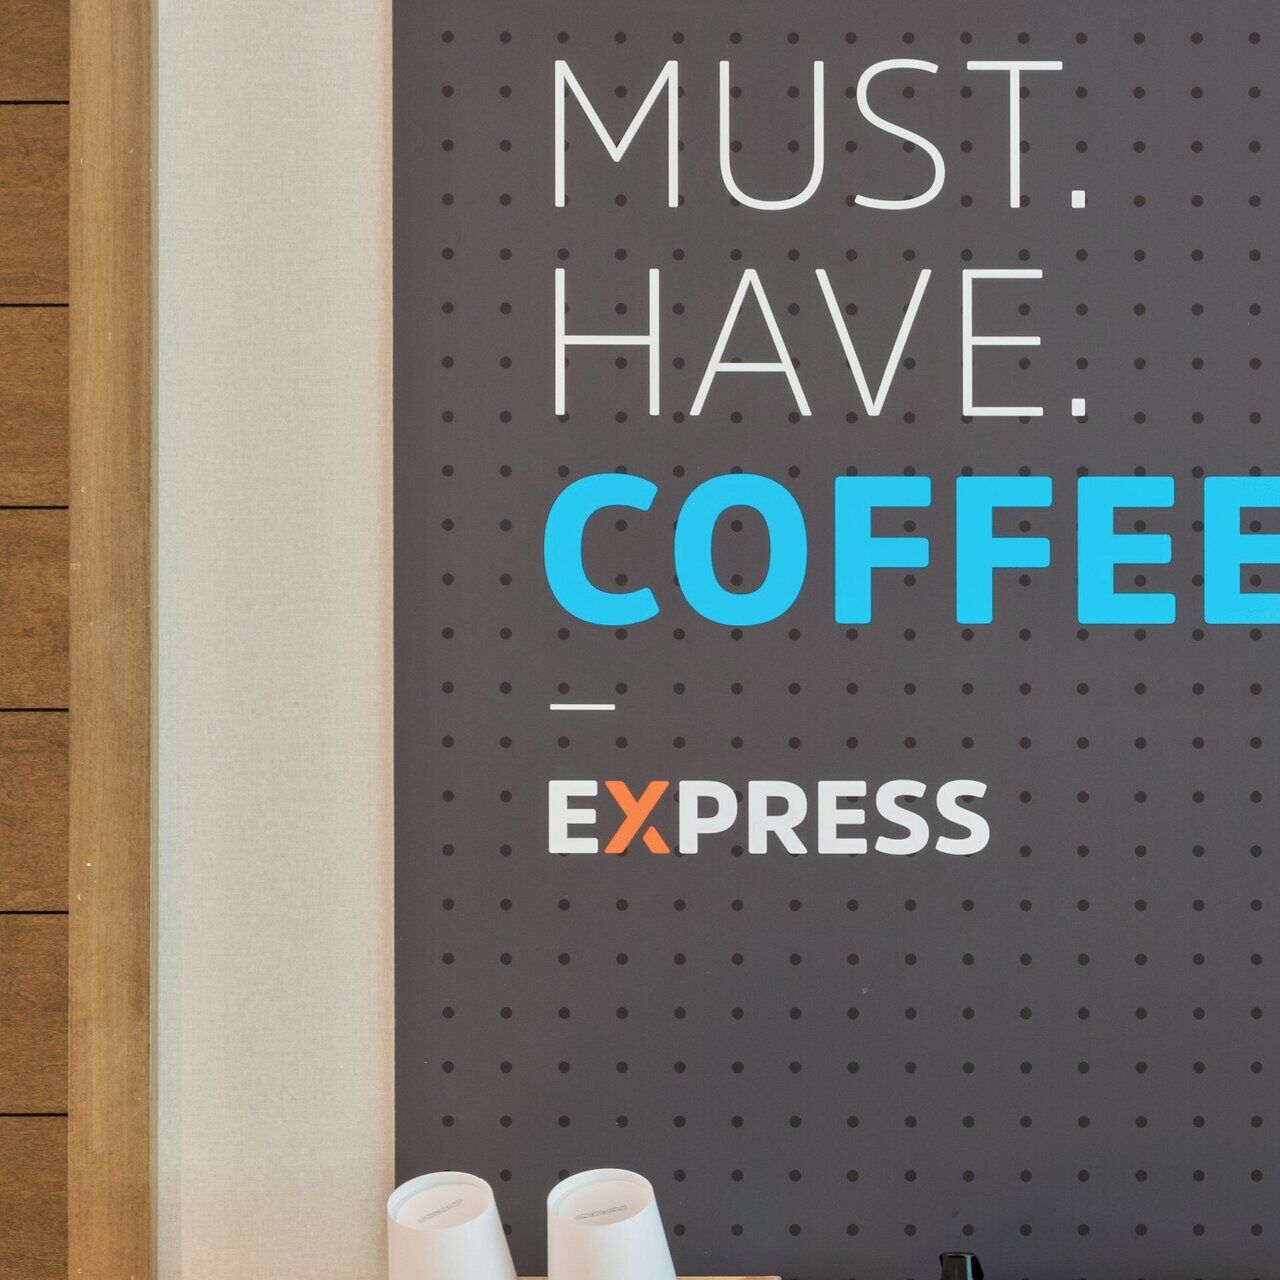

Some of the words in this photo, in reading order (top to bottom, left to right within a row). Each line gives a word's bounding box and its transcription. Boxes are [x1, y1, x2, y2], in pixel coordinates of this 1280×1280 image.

[555, 59, 1086, 210] MUST.
[555, 268, 1086, 416] HAVE.
[548, 779, 990, 855] EXPRESS
